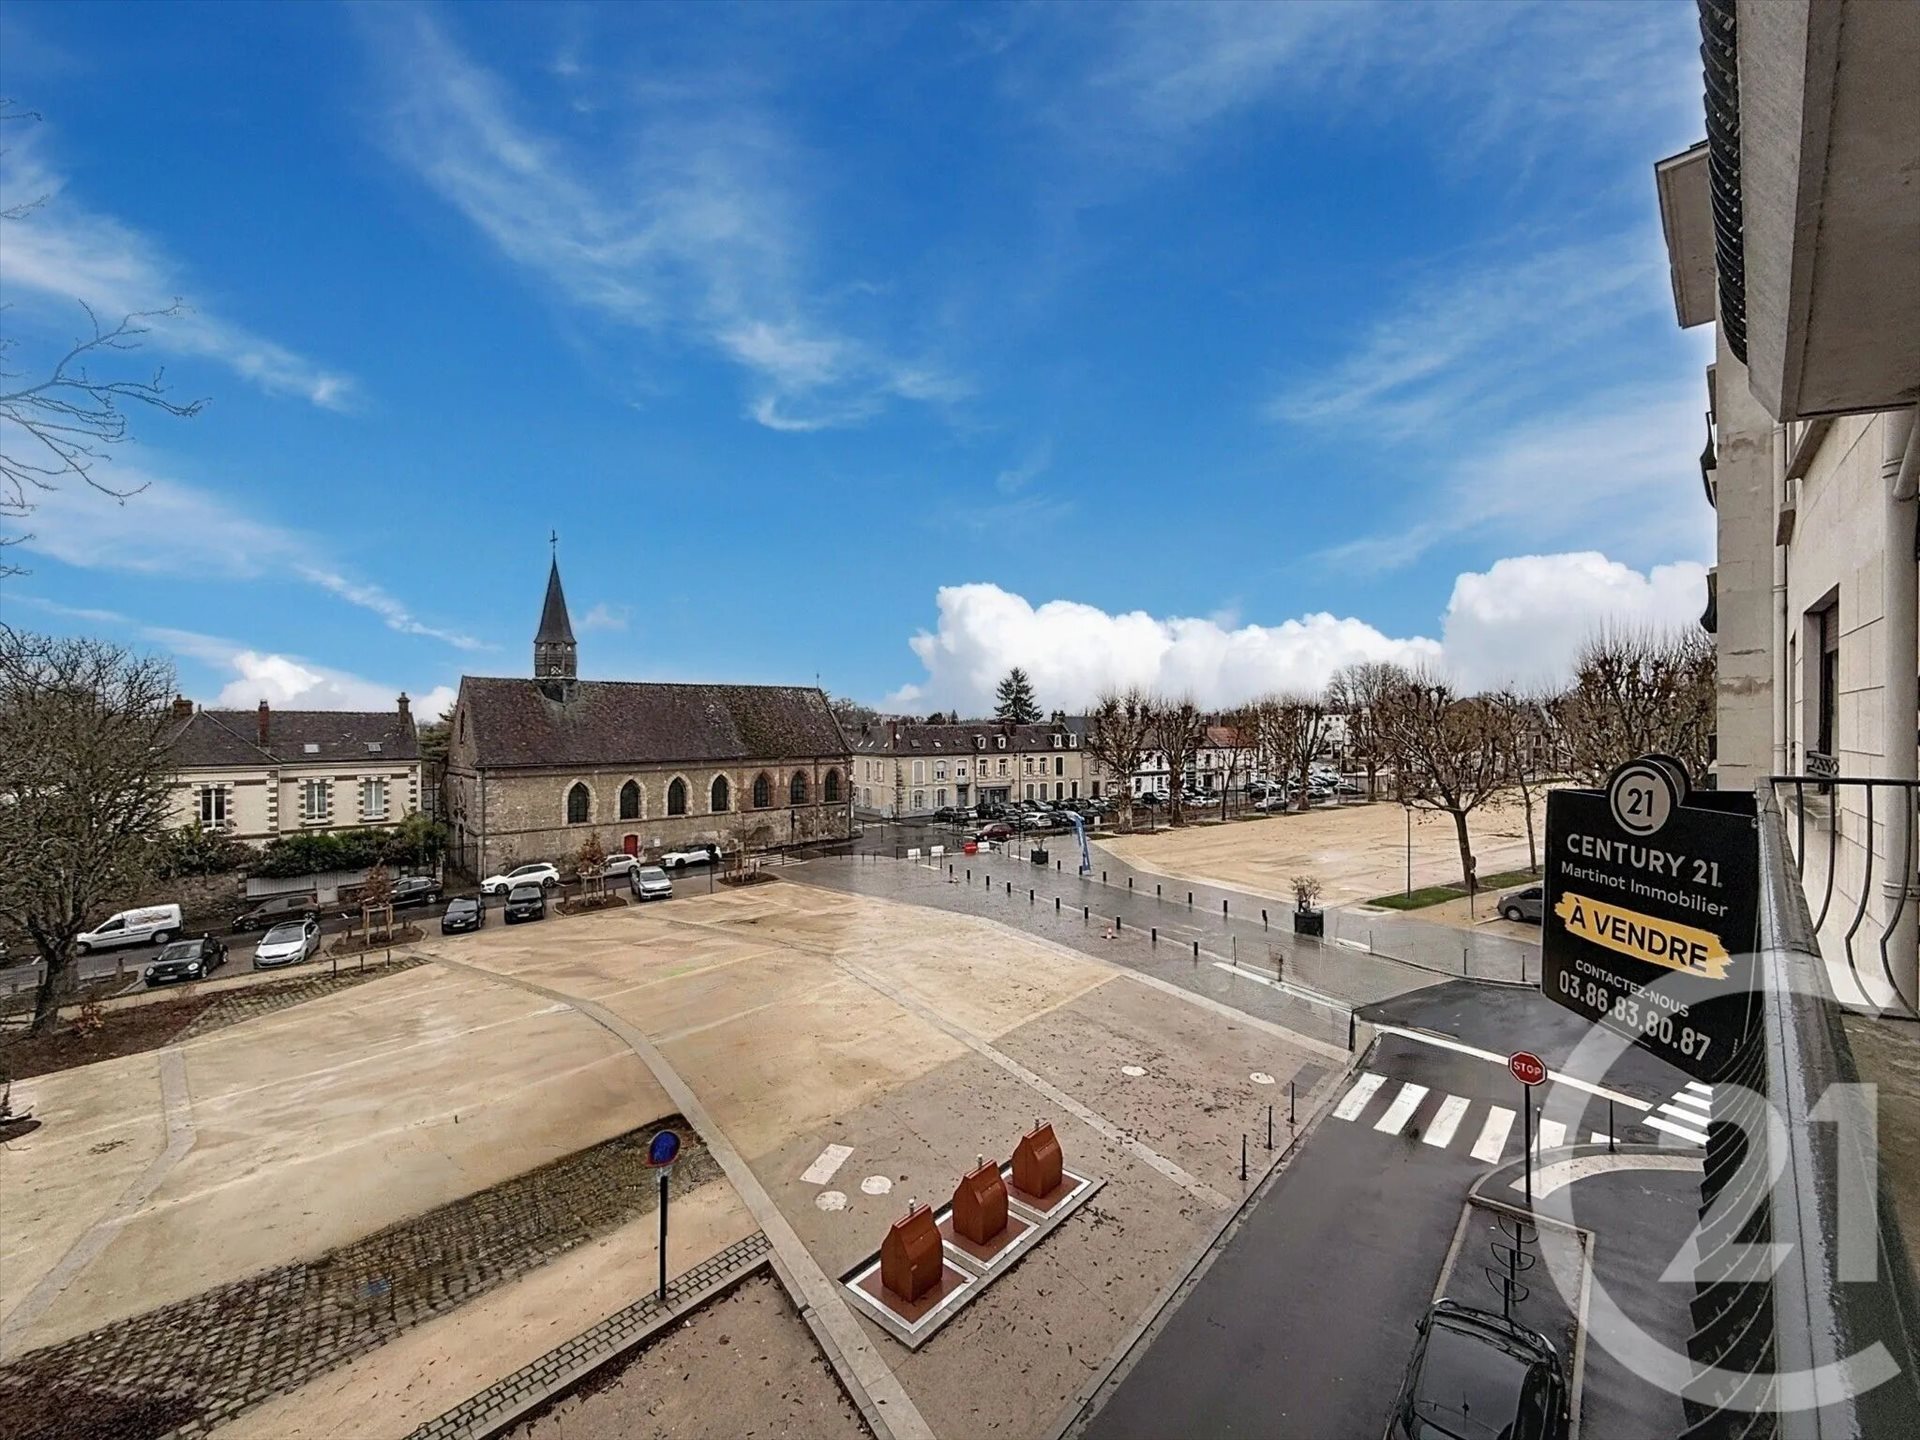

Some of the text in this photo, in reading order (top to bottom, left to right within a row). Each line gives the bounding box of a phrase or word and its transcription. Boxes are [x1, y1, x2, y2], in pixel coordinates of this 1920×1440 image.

[1567, 833, 1686, 879] CENTURY
[1561, 861, 1729, 918] Martinot Immobilier
[1569, 897, 1709, 974] À VENDRE
[1559, 970, 1712, 1062] 03.86.83.80.87
[1575, 959, 1690, 1018] CONTACTEZ-NOUS
[1513, 1061, 1541, 1076] STOP
